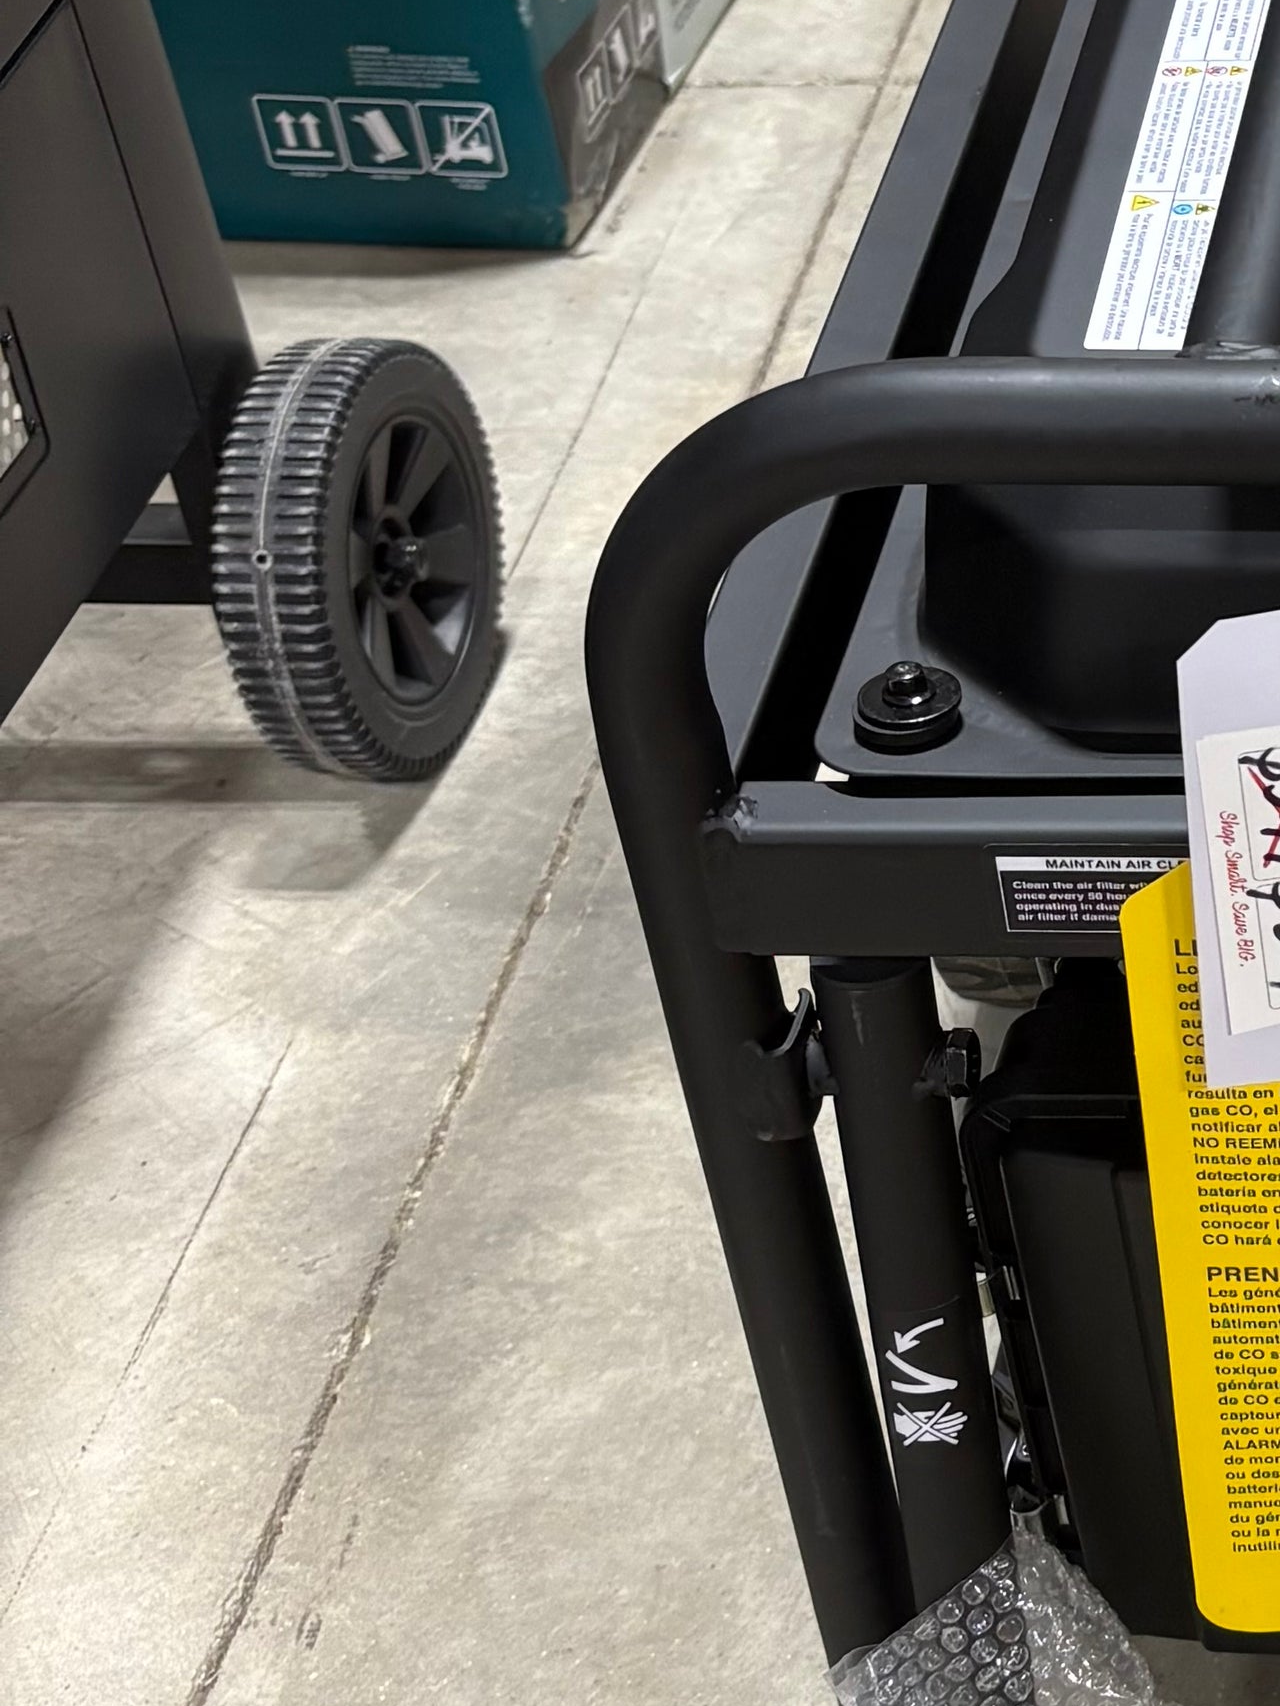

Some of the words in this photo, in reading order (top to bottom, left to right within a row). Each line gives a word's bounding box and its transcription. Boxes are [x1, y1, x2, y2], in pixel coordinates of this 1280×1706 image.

[1215, 811, 1239, 846] Shop
[1045, 859, 1120, 868] MAINTAIN
[1125, 860, 1151, 869] AIR
[1224, 850, 1249, 897] Smart.
[1012, 880, 1049, 889] Clean
[1052, 881, 1073, 889] the
[1076, 881, 1093, 890] air
[1096, 880, 1125, 890] filter
[1048, 893, 1083, 903] every
[1087, 892, 1103, 900] 50
[1016, 902, 1076, 913] operating
[1080, 902, 1093, 910] in
[1018, 912, 1033, 920] air
[1037, 912, 1065, 920] filter
[1232, 903, 1249, 935] Save
[1193, 1136, 1219, 1147] NO
[1202, 1233, 1228, 1244] CO
[1234, 1234, 1271, 1245] hará
